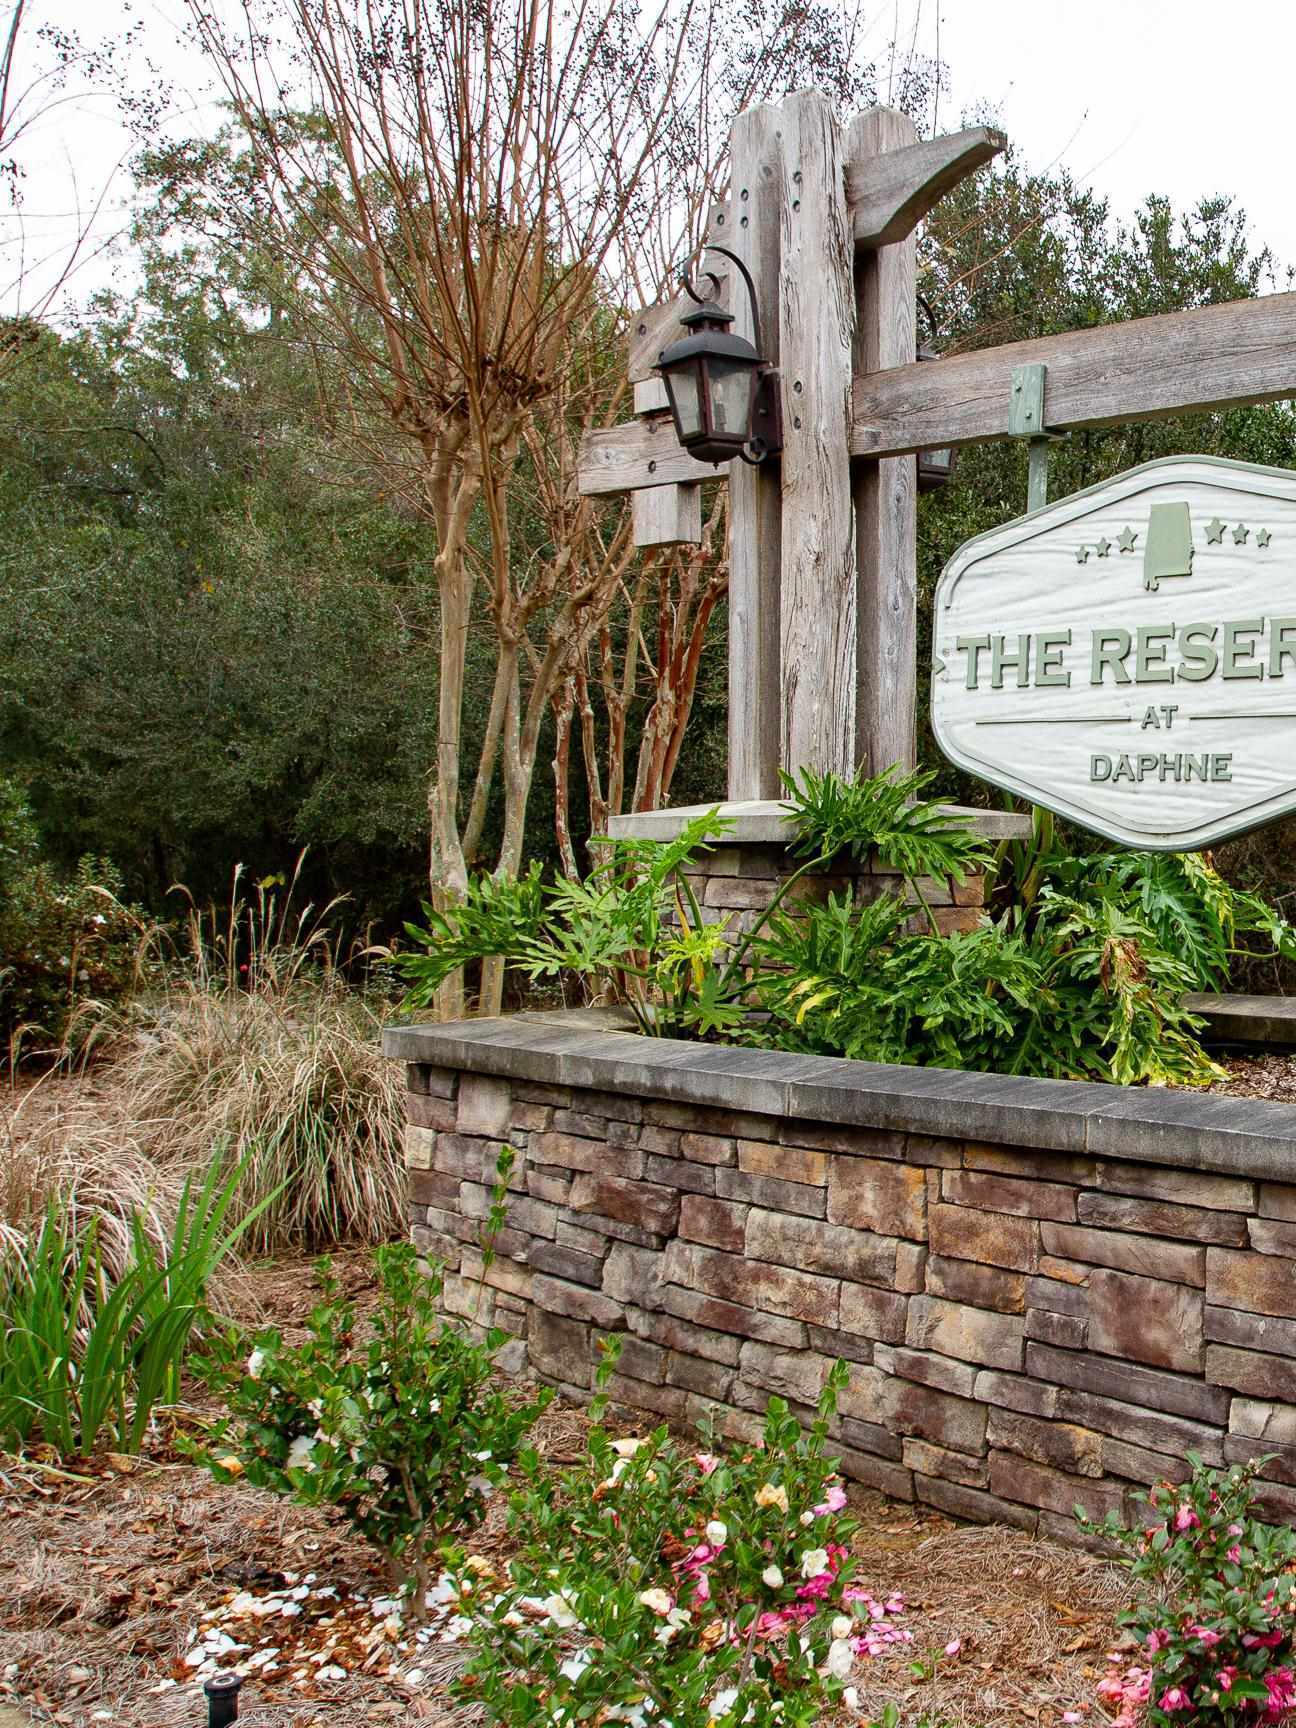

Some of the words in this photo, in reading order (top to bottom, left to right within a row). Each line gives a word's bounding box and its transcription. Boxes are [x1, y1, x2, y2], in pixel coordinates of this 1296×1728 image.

[956, 628, 1072, 689] THE
[1140, 704, 1179, 729] AT
[1089, 752, 1233, 782] DAPHNE
